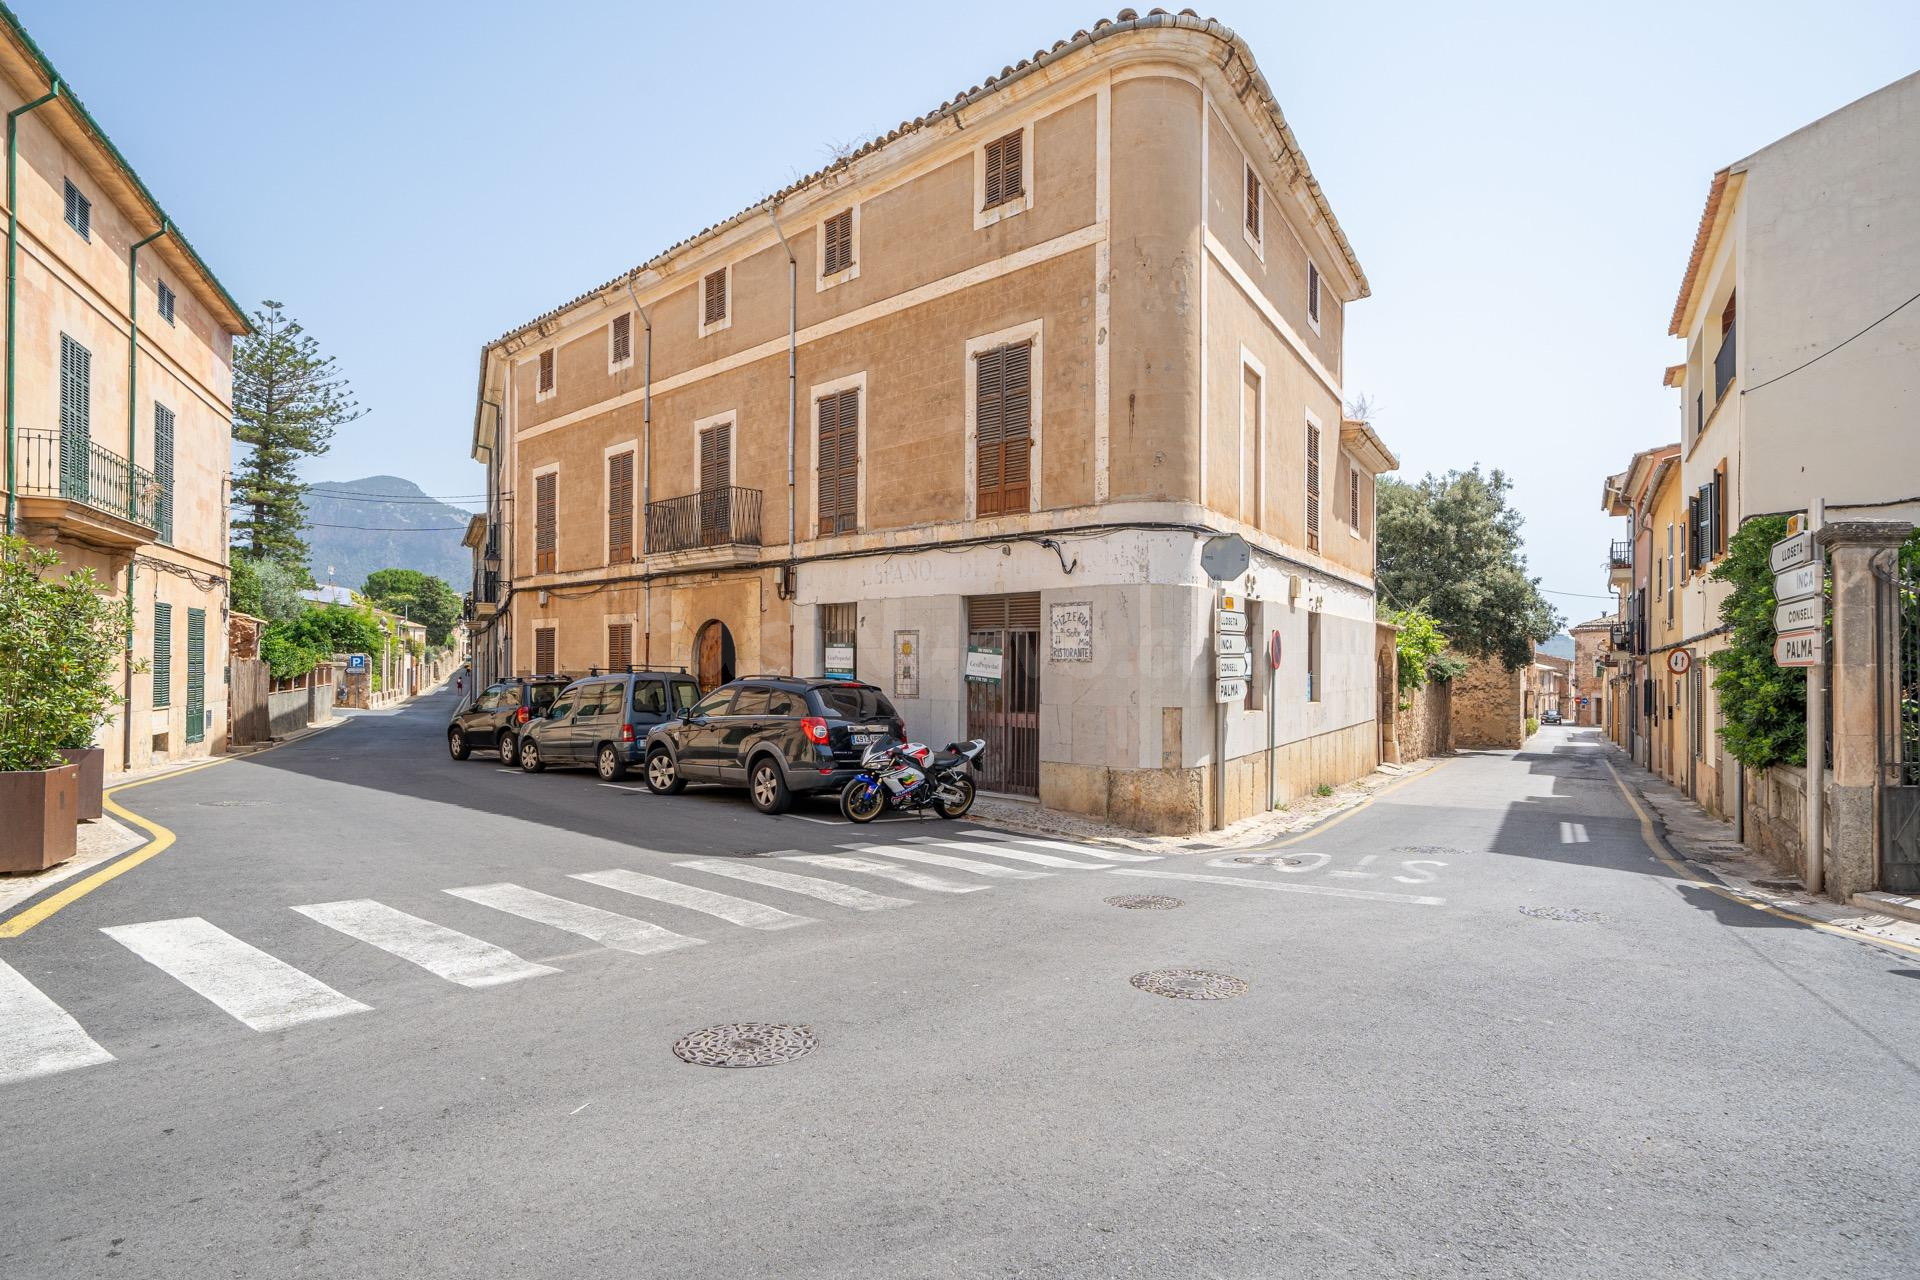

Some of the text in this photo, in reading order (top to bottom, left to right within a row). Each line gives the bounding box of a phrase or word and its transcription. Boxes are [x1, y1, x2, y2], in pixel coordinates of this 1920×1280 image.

[1781, 543, 1803, 562] LLOSETA
[1796, 570, 1814, 590] INCA
[1053, 611, 1089, 630] PIZZERIA
[1788, 607, 1814, 624] CONSELL
[1053, 647, 1089, 658] RISTORANTE
[1786, 638, 1813, 659] PALMA
[352, 658, 361, 667] P
[1220, 683, 1239, 697] PALMA
